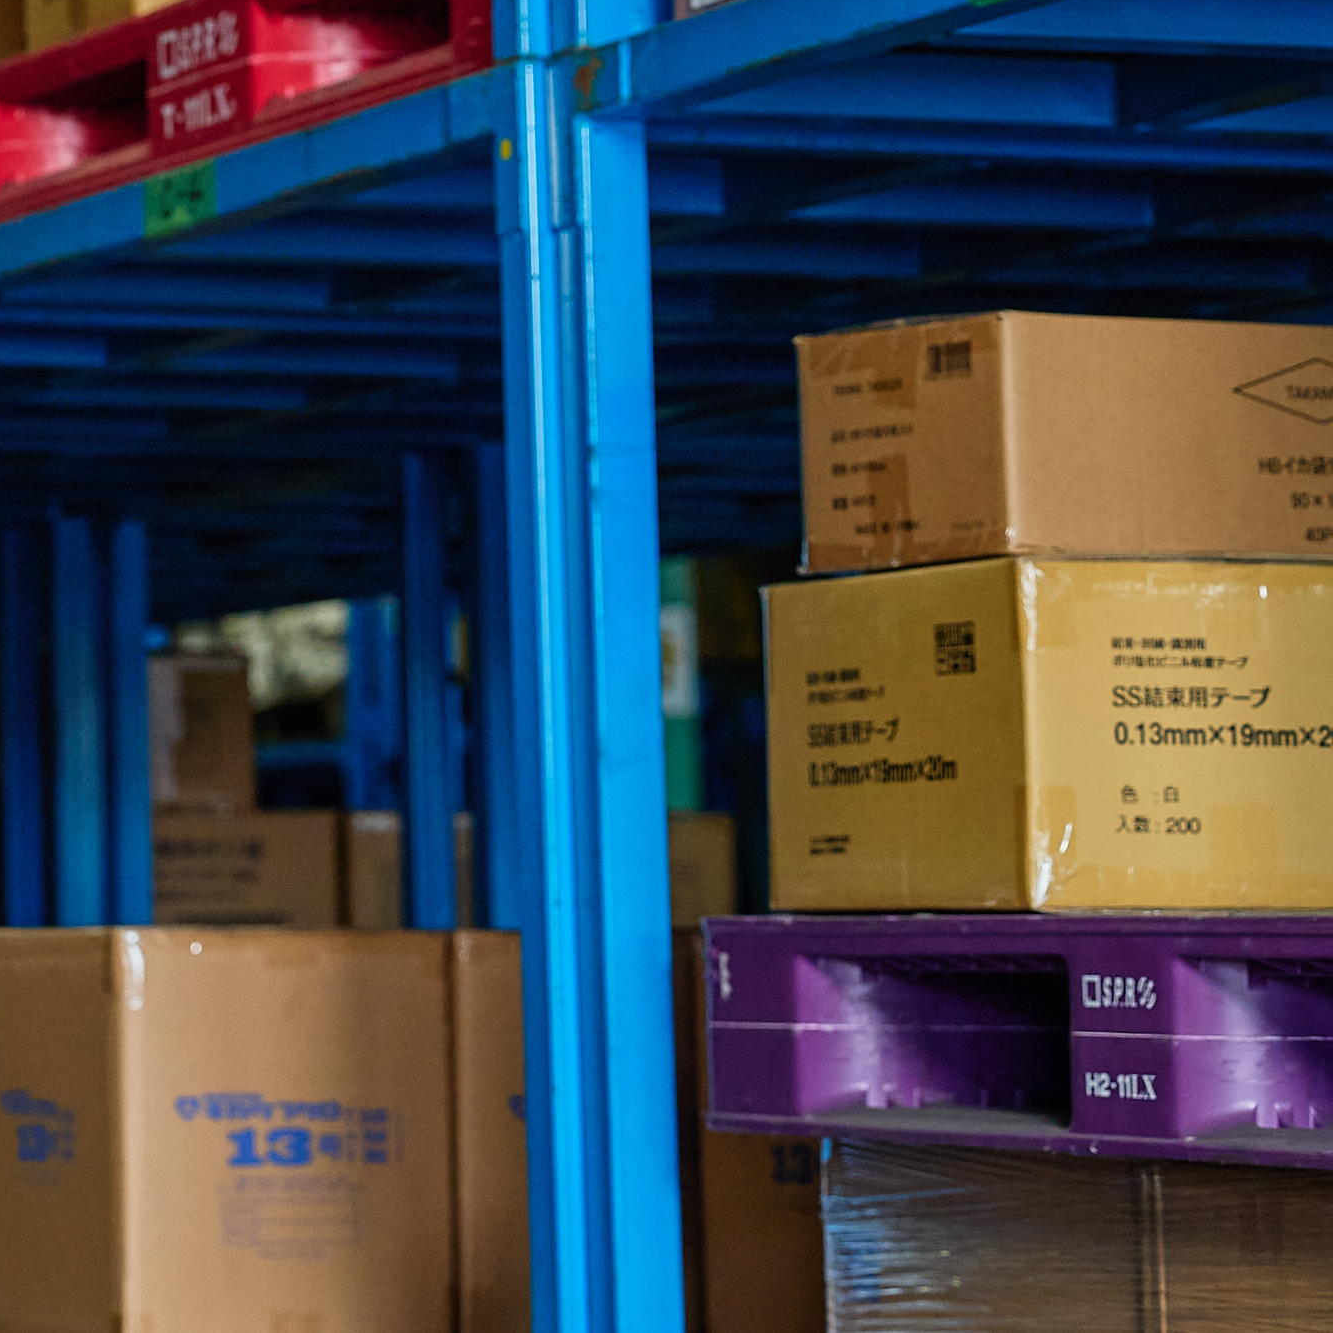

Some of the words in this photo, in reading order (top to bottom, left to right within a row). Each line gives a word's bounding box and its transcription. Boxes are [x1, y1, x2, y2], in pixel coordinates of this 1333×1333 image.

[1112, 684, 1271, 709] SS結束用テープ
